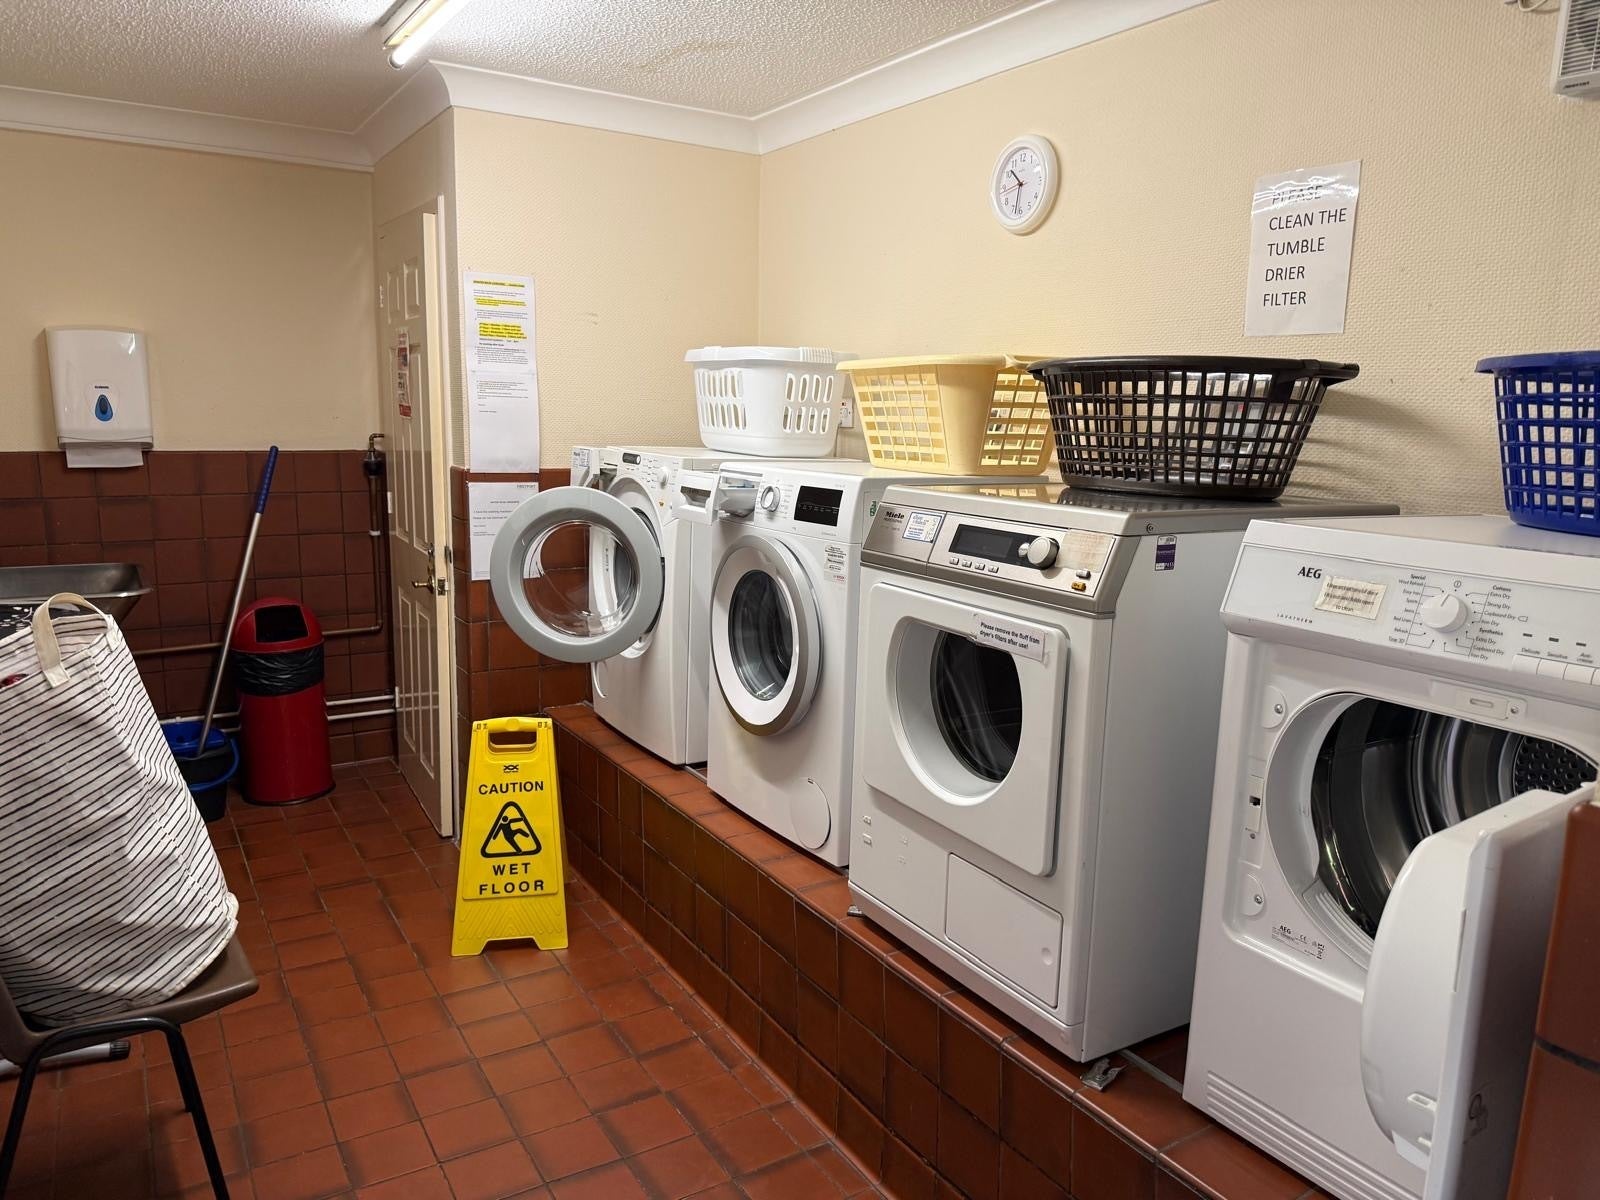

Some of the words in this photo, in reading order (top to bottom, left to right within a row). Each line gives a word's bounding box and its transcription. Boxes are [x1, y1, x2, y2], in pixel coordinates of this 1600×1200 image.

[1012, 159, 1017, 168] 11
[1020, 153, 1026, 162] 12
[1269, 212, 1314, 231] CLEAN
[1319, 208, 1347, 225] THE
[1267, 237, 1326, 257] TUMBLE
[1265, 266, 1305, 282] DRIER
[1263, 291, 1306, 307] FILTER
[886, 511, 905, 519] Miele
[1297, 566, 1322, 579] AEG
[1484, 610, 1507, 618] Cupboard
[980, 621, 994, 631] Please
[995, 626, 1010, 635] remove
[1029, 636, 1040, 644] from
[980, 630, 994, 639] dryer's
[994, 634, 1007, 643] filters
[1007, 638, 1018, 646] after
[1479, 628, 1503, 636] Synthetics
[478, 781, 544, 795] CAUTION
[492, 862, 531, 876] WET
[479, 880, 545, 895] FLOOR
[1280, 925, 1291, 934] AEG
